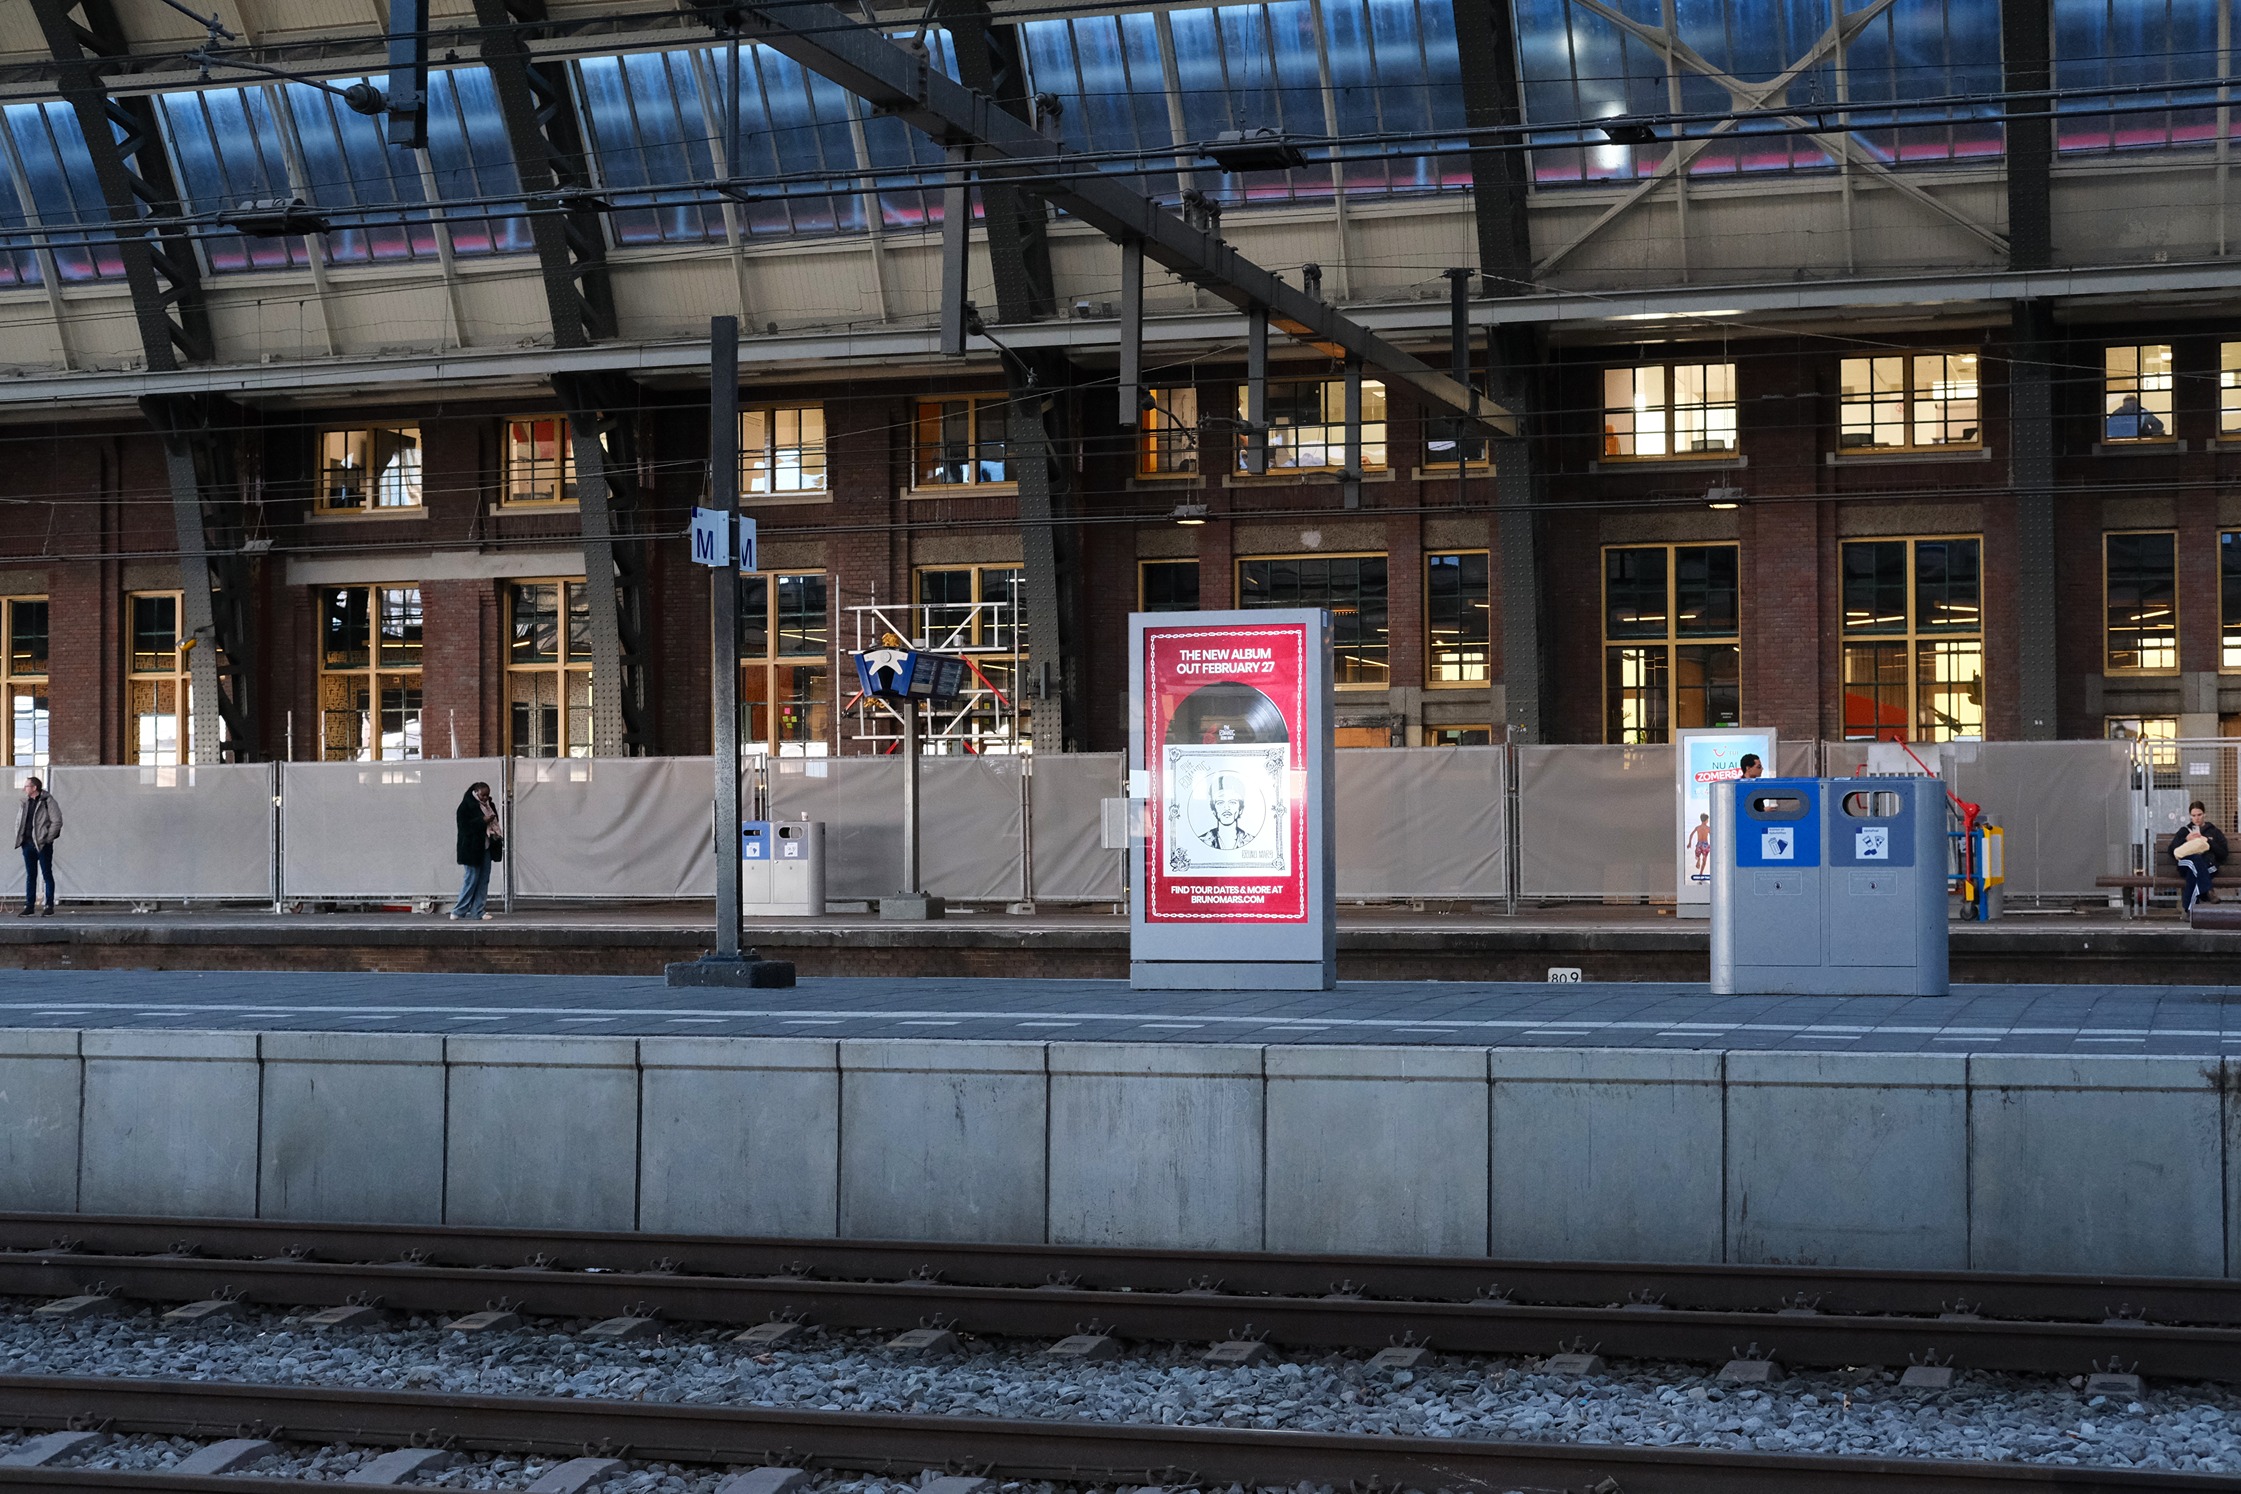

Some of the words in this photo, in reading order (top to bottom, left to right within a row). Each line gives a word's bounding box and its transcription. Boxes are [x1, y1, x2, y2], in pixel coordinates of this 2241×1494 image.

[697, 528, 713, 560] M
[741, 538, 752, 568] M
[1179, 649, 1201, 661] THE
[1202, 649, 1230, 660] NEW
[1231, 648, 1272, 660] ALBUM
[1176, 663, 1201, 674] OUT
[1202, 662, 1260, 674] FEBRUARY
[1261, 661, 1275, 673] 27
[1712, 761, 1727, 770] NU
[1170, 886, 1190, 894] FIND
[1190, 886, 1213, 894] TOUR
[1213, 886, 1239, 894] DATES
[1240, 886, 1246, 894] &
[1247, 886, 1271, 894] MORE
[1271, 886, 1283, 894] AT
[1191, 895, 1265, 904] BRUNOMARS.COM
